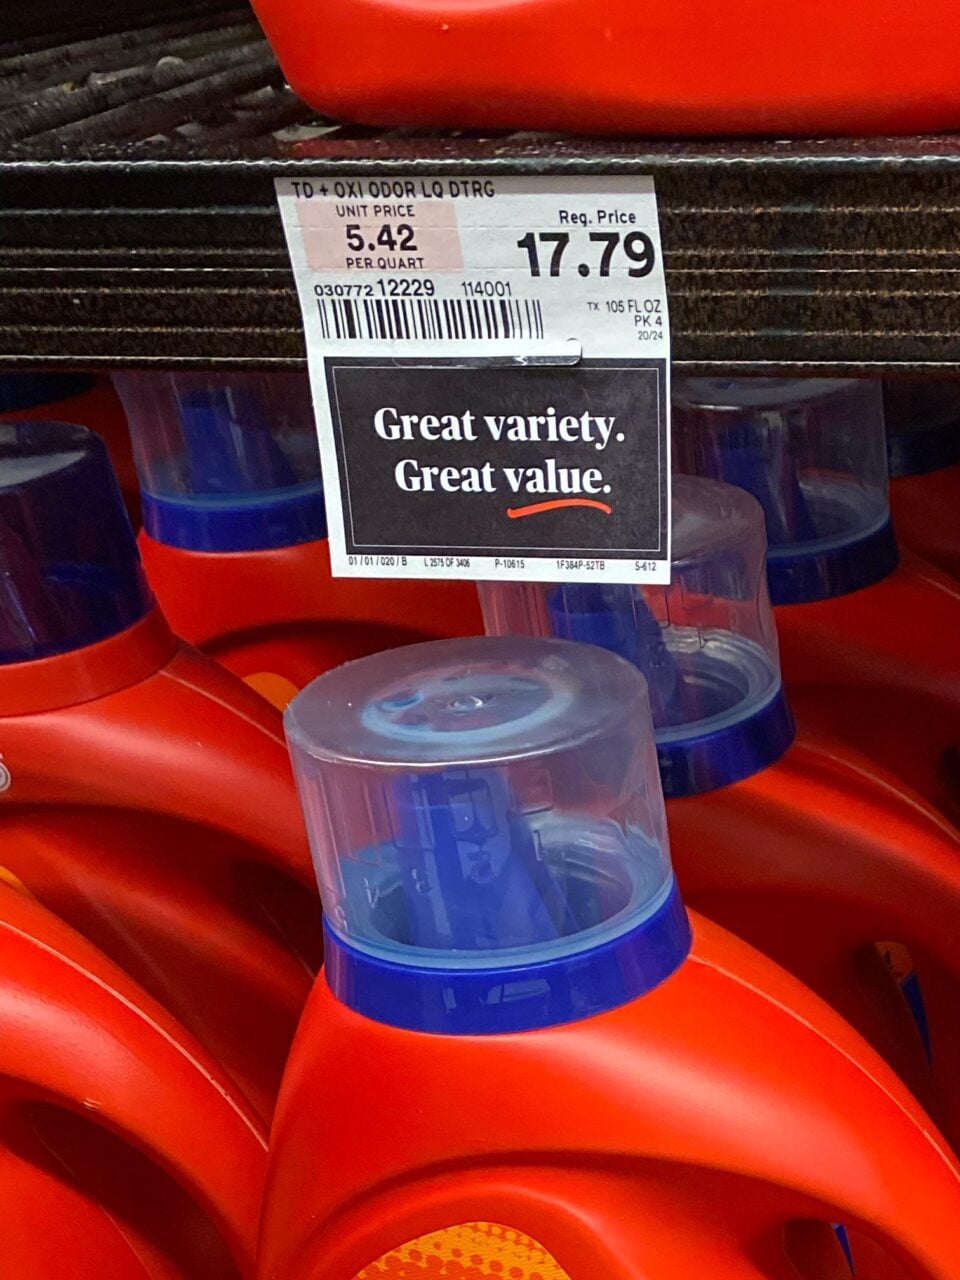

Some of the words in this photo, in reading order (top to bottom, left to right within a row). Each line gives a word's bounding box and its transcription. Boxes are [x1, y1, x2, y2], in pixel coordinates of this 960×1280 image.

[291, 181, 314, 199] TD
[334, 181, 363, 199] OXI
[368, 181, 416, 199] ODOR
[421, 181, 445, 199] LQ
[449, 180, 495, 198] DTRG
[335, 205, 368, 217] UNIT
[374, 205, 415, 217] PRICE
[558, 210, 592, 227] Reg.
[597, 210, 636, 224] Price
[346, 224, 418, 251] 5.42
[346, 258, 373, 269] PER
[377, 257, 424, 269] QUART
[517, 231, 656, 278] 17.79
[314, 284, 374, 297] 030772
[377, 279, 435, 297] 12229
[461, 281, 512, 297] 114001
[606, 300, 625, 313] 105
[628, 300, 641, 313] FL
[644, 300, 662, 313] OZ
[634, 315, 651, 327] PK
[654, 316, 663, 327] 4
[373, 406, 477, 442] Great
[485, 406, 625, 450] variety.
[394, 458, 497, 493] Great
[504, 458, 612, 494] value.
